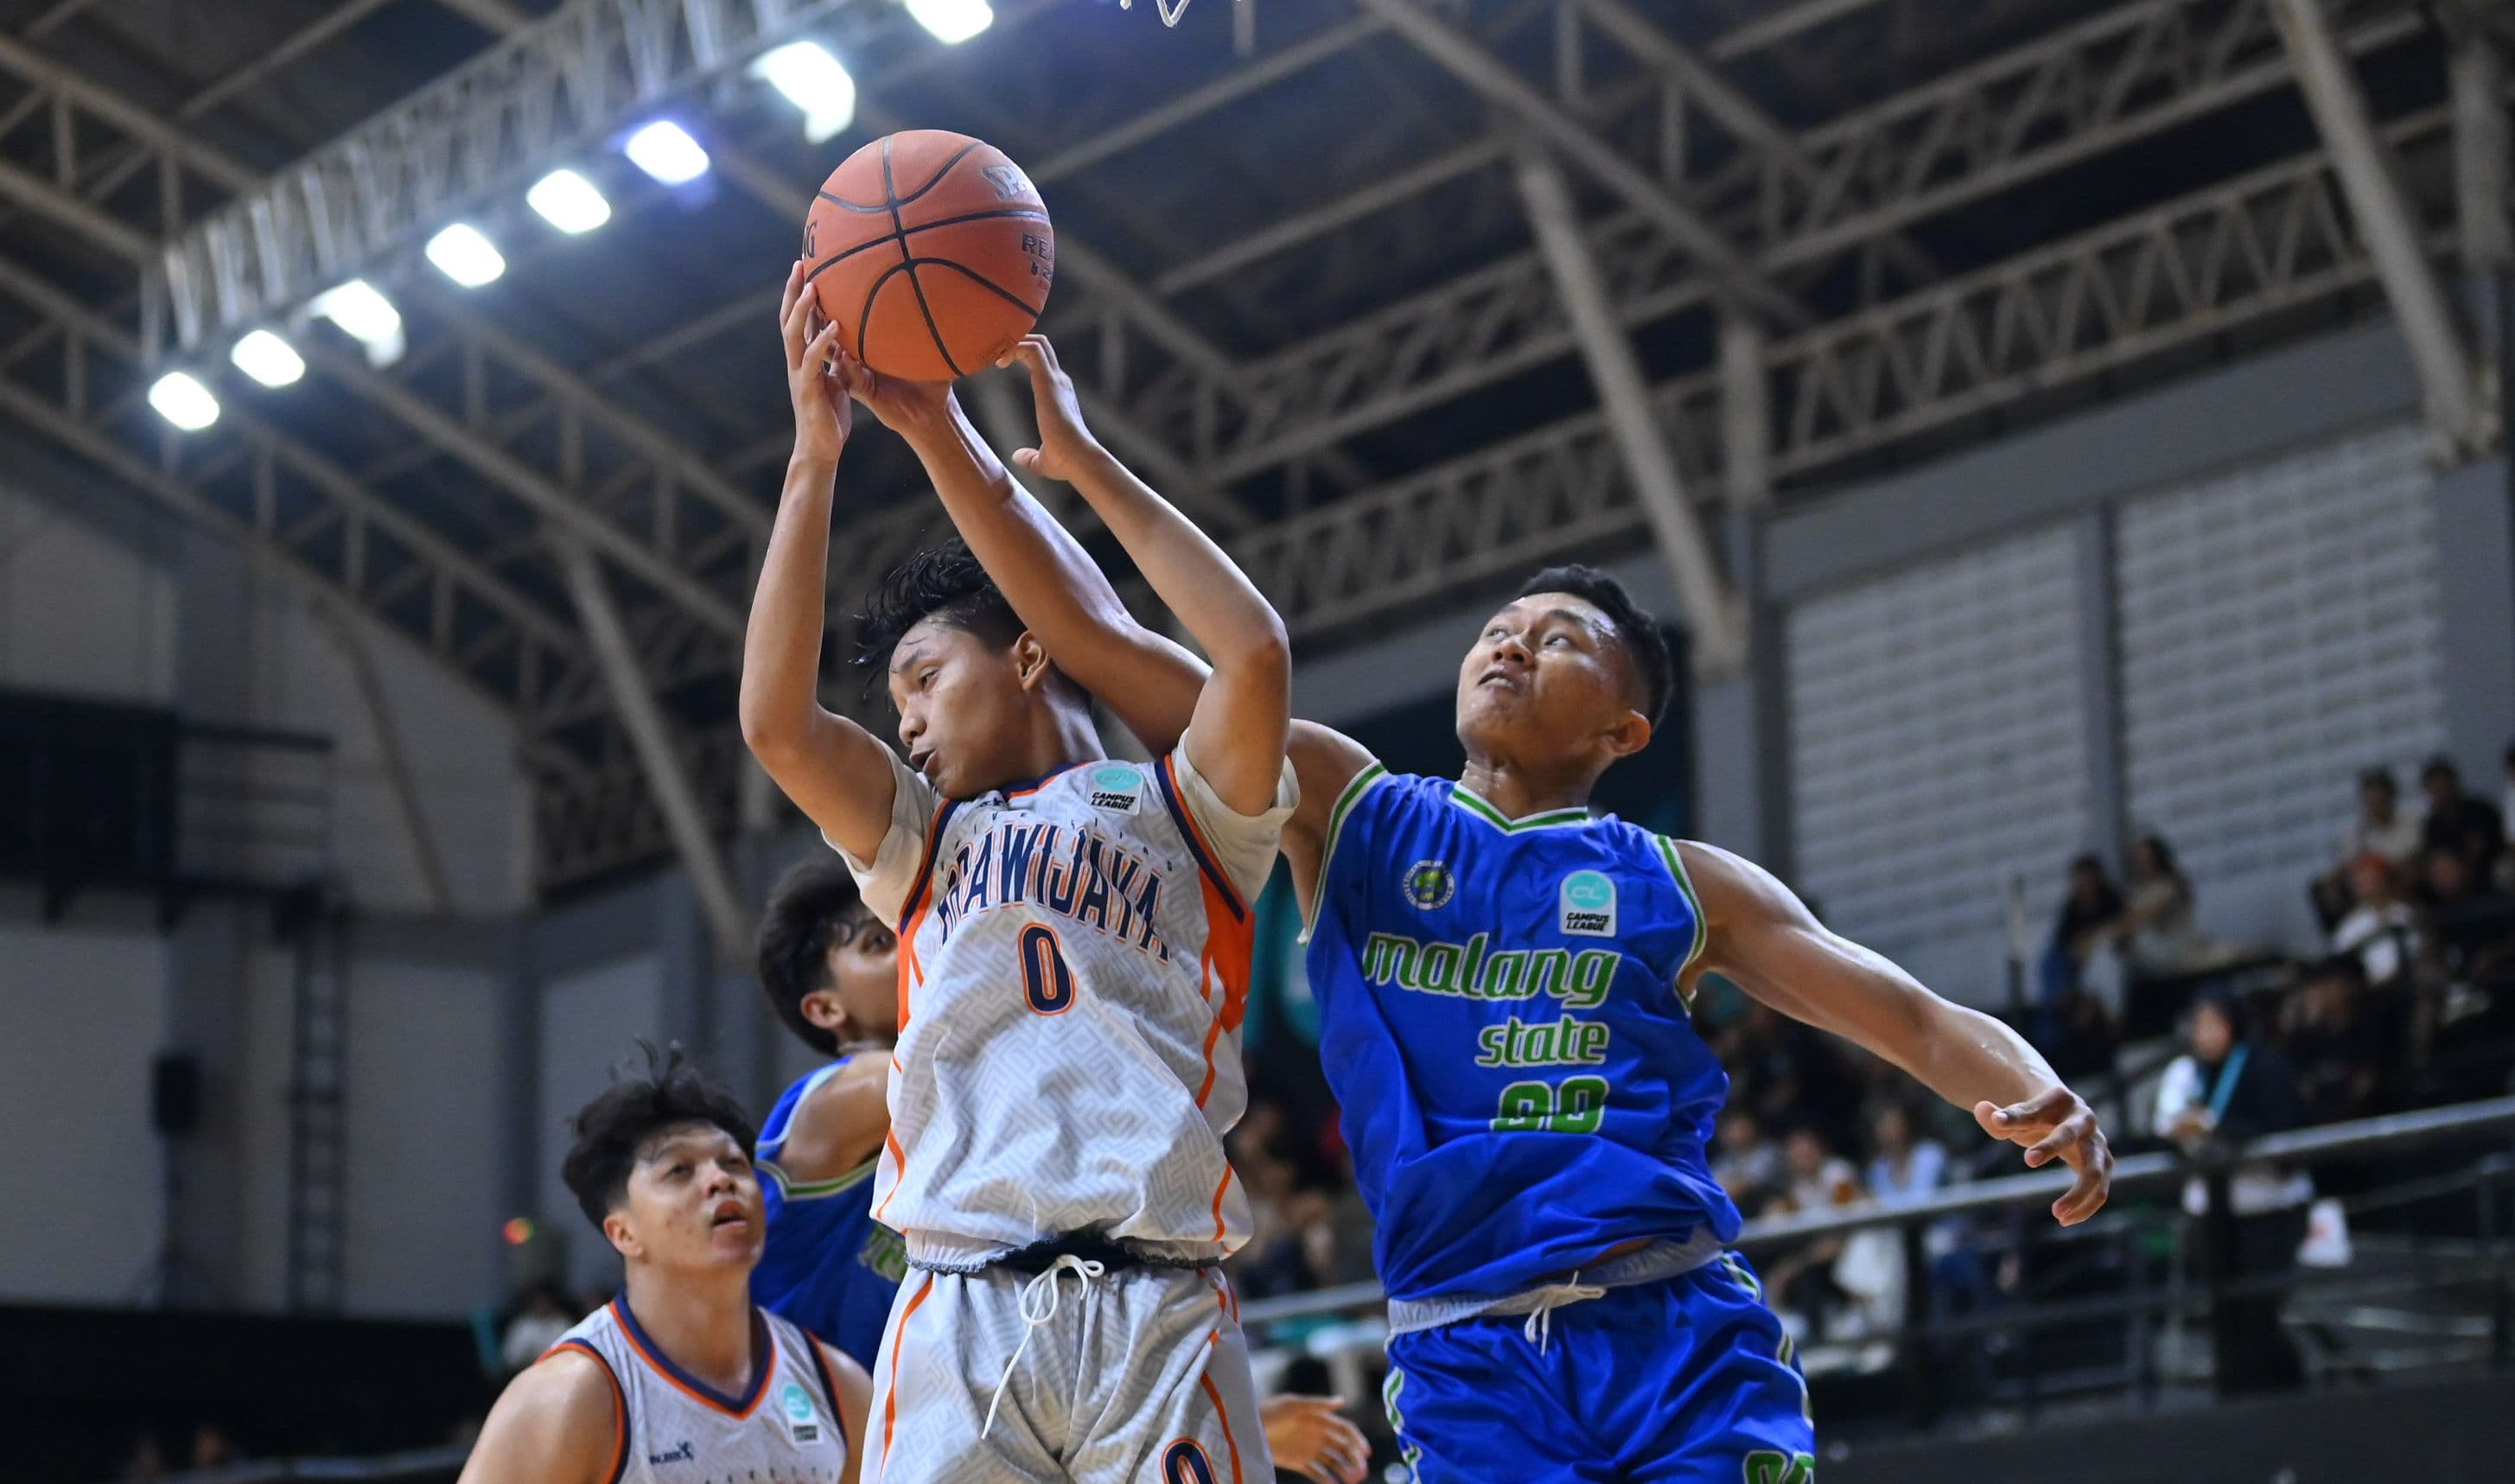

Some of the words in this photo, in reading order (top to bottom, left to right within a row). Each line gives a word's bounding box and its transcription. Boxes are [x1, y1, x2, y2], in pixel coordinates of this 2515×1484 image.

[1092, 792, 1136, 803] CAMPUS
[1091, 799, 1132, 811] LEAGUE
[1566, 912, 1610, 923] CAMPUS
[1566, 920, 1607, 932] LEAGUE
[1018, 921, 1076, 1016] 0
[1362, 932, 1622, 1010] malang
[1474, 1013, 1610, 1067] state
